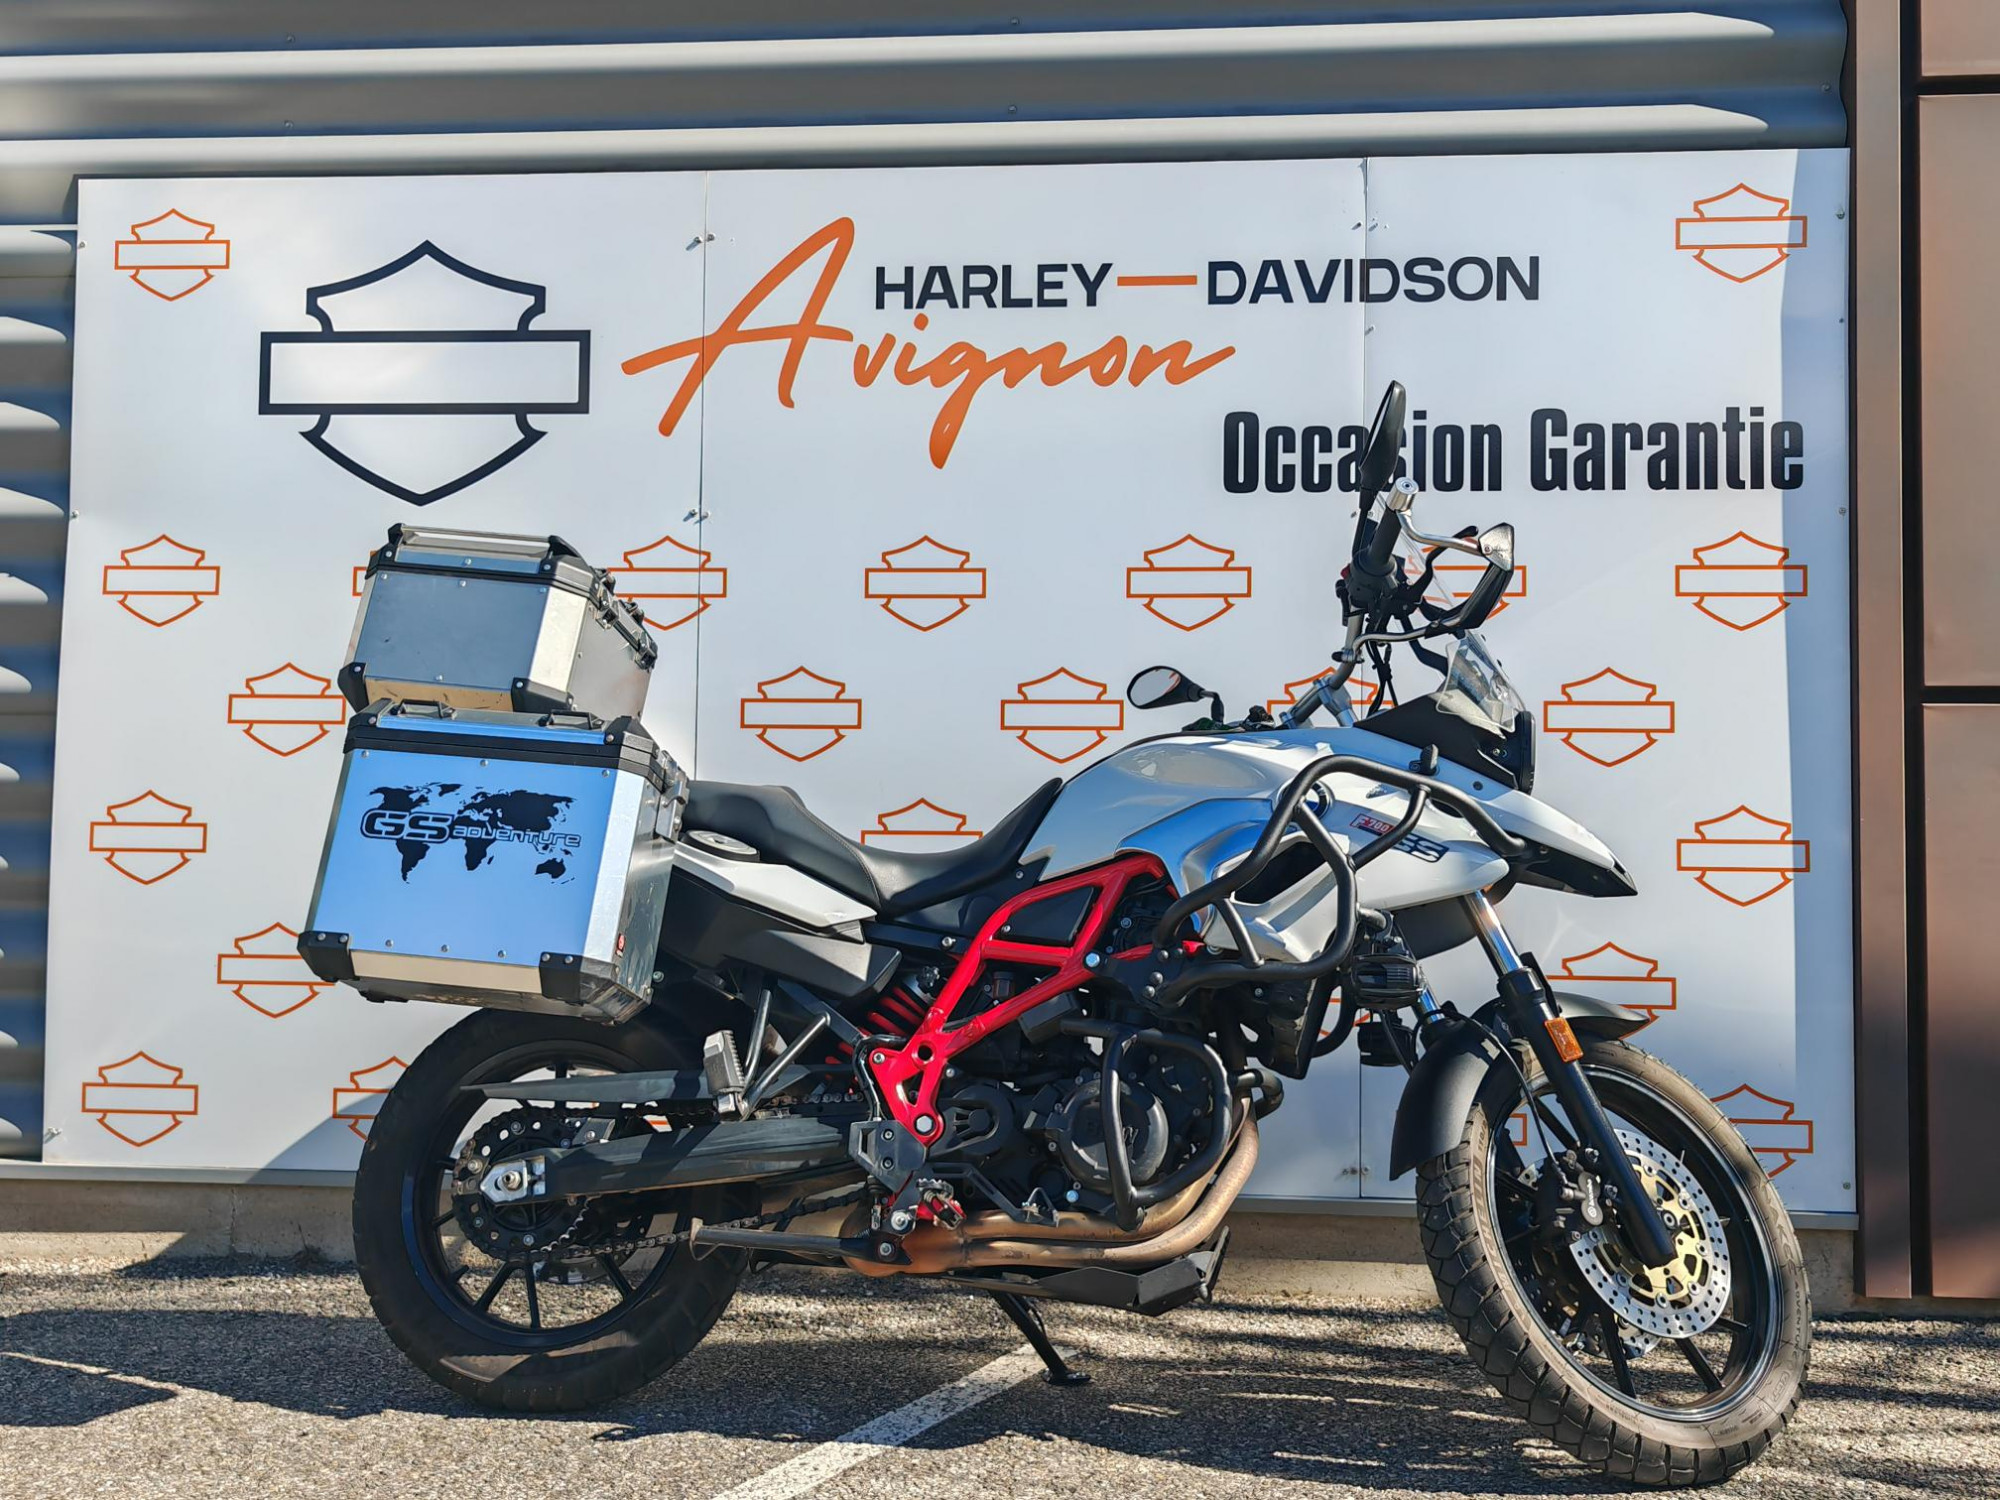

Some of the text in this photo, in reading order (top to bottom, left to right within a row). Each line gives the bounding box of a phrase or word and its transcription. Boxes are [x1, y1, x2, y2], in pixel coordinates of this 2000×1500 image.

[622, 218, 1235, 468] Avignon
[1530, 406, 1804, 491] Garantie
[360, 808, 454, 843] GS
[1473, 1160, 1512, 1292] MICHELIN
